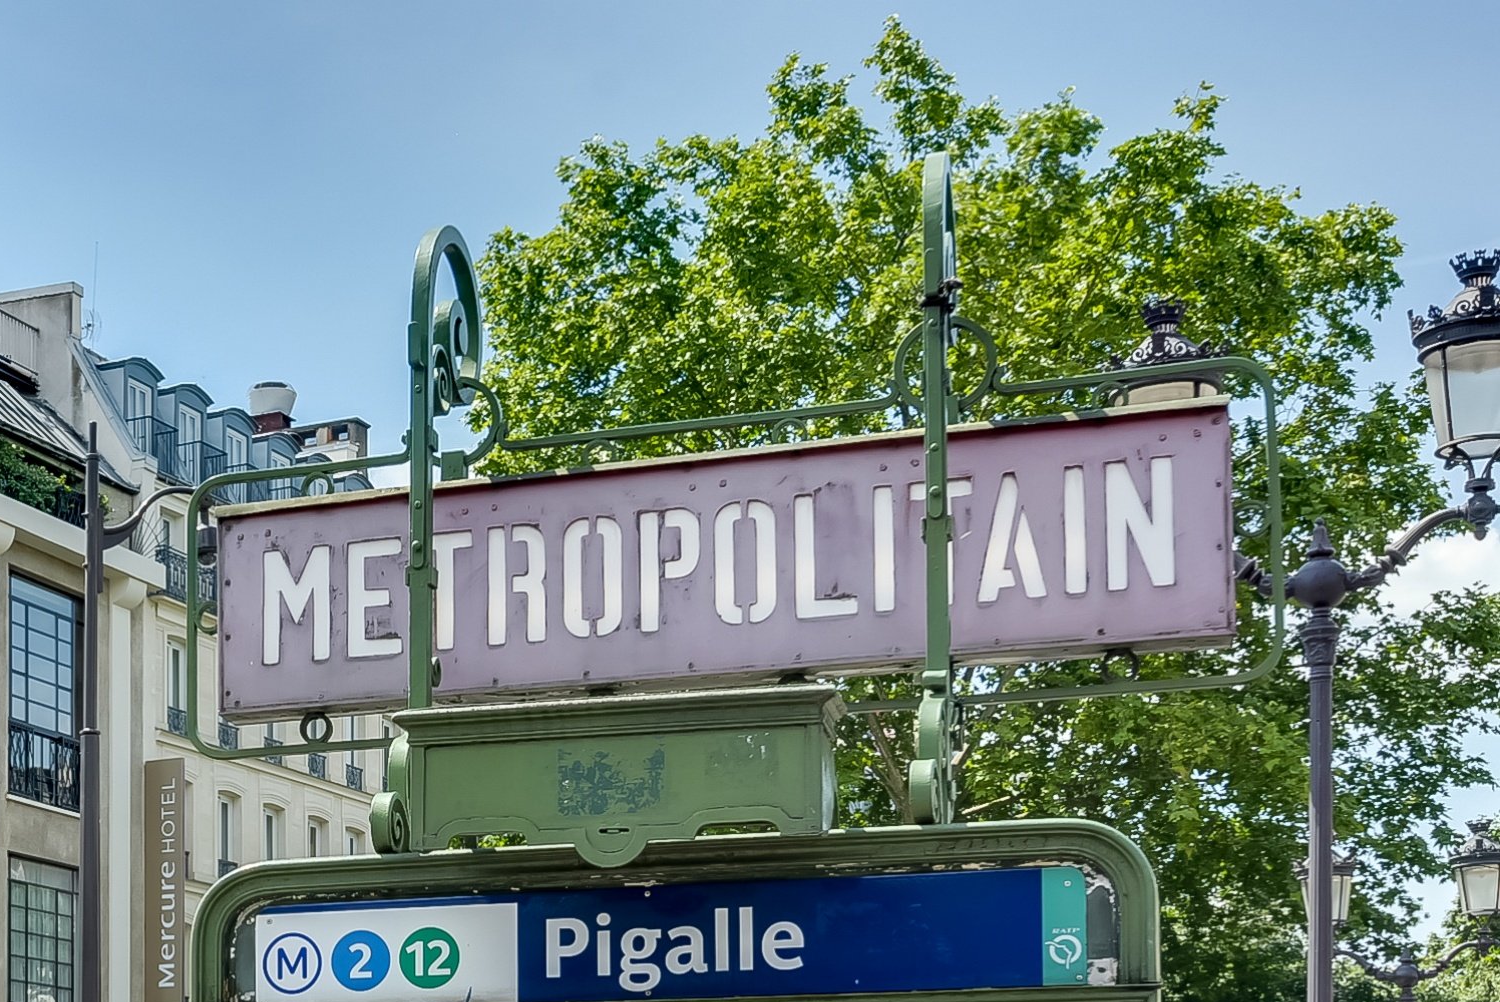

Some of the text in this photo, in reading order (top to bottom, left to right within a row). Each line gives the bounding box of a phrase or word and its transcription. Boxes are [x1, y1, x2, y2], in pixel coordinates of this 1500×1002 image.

[157, 777, 176, 988] Mercure HOTEL
[348, 941, 373, 980] 2
[405, 939, 452, 977] 12
[545, 906, 805, 992] Pigalle
